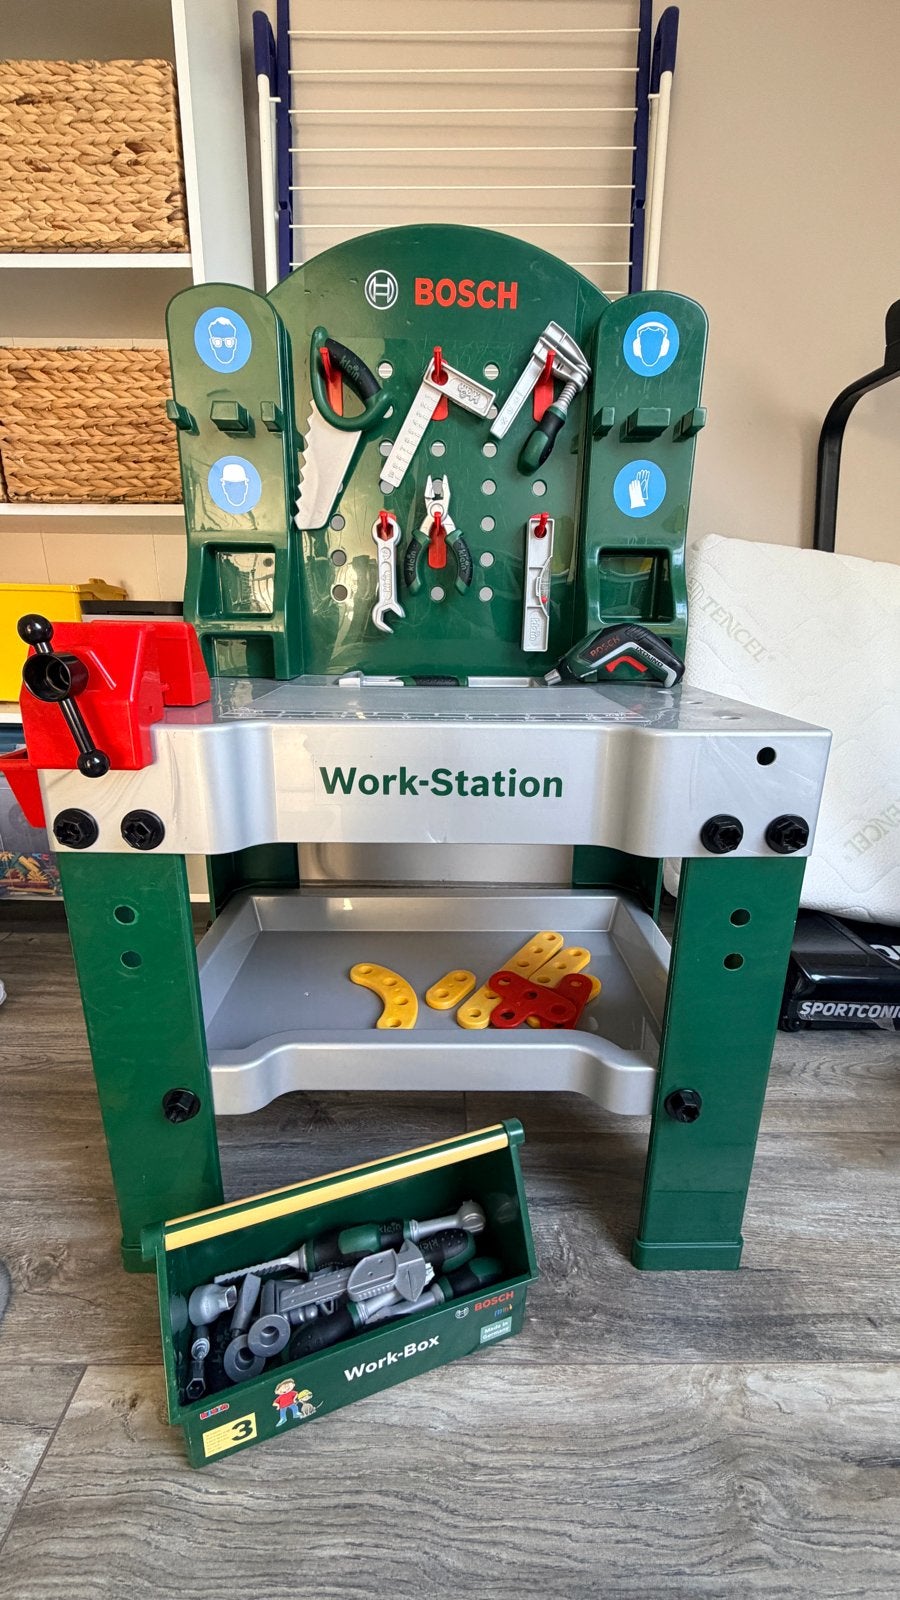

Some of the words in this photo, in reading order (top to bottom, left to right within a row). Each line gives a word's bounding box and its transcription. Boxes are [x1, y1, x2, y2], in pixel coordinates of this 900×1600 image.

[414, 277, 518, 310] BOSCH
[340, 355, 360, 381] klein
[408, 549, 417, 571] klein
[458, 548, 469, 571] klein
[699, 595, 768, 663] TENCEL
[589, 635, 621, 658] BOSCH
[319, 766, 563, 797] Work-Station
[474, 1291, 514, 1312] BOSCH
[482, 1327, 509, 1340] Germany
[484, 1324, 501, 1333] Made
[344, 1334, 440, 1382] Work-Box
[231, 1419, 253, 1441] 3
